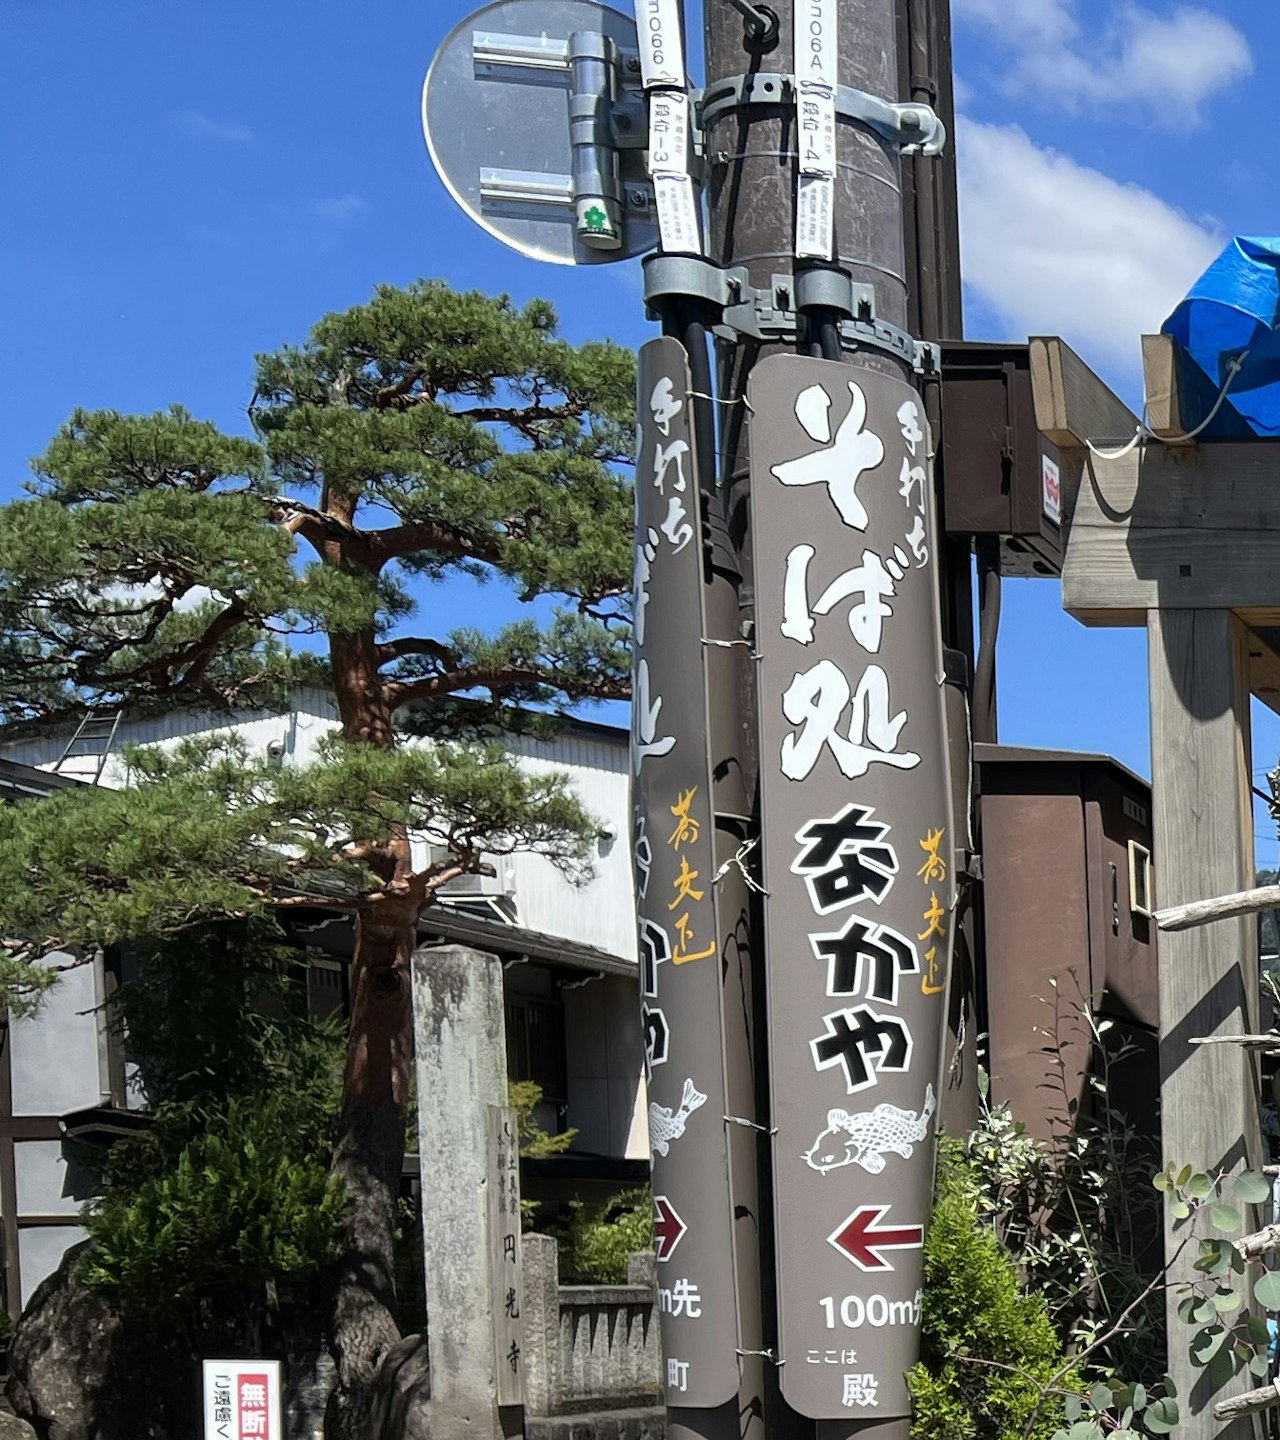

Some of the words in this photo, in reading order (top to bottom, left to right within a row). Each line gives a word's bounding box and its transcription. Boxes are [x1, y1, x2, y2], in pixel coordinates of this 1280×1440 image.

[650, 377, 694, 555] 手打ち
[896, 400, 929, 568] 手打ち
[769, 381, 923, 782] そば処
[502, 1233, 521, 1375] 円光寺
[666, 1357, 690, 1393] 町
[806, 1348, 858, 1365] ここは
[841, 1372, 880, 1408] 殿
